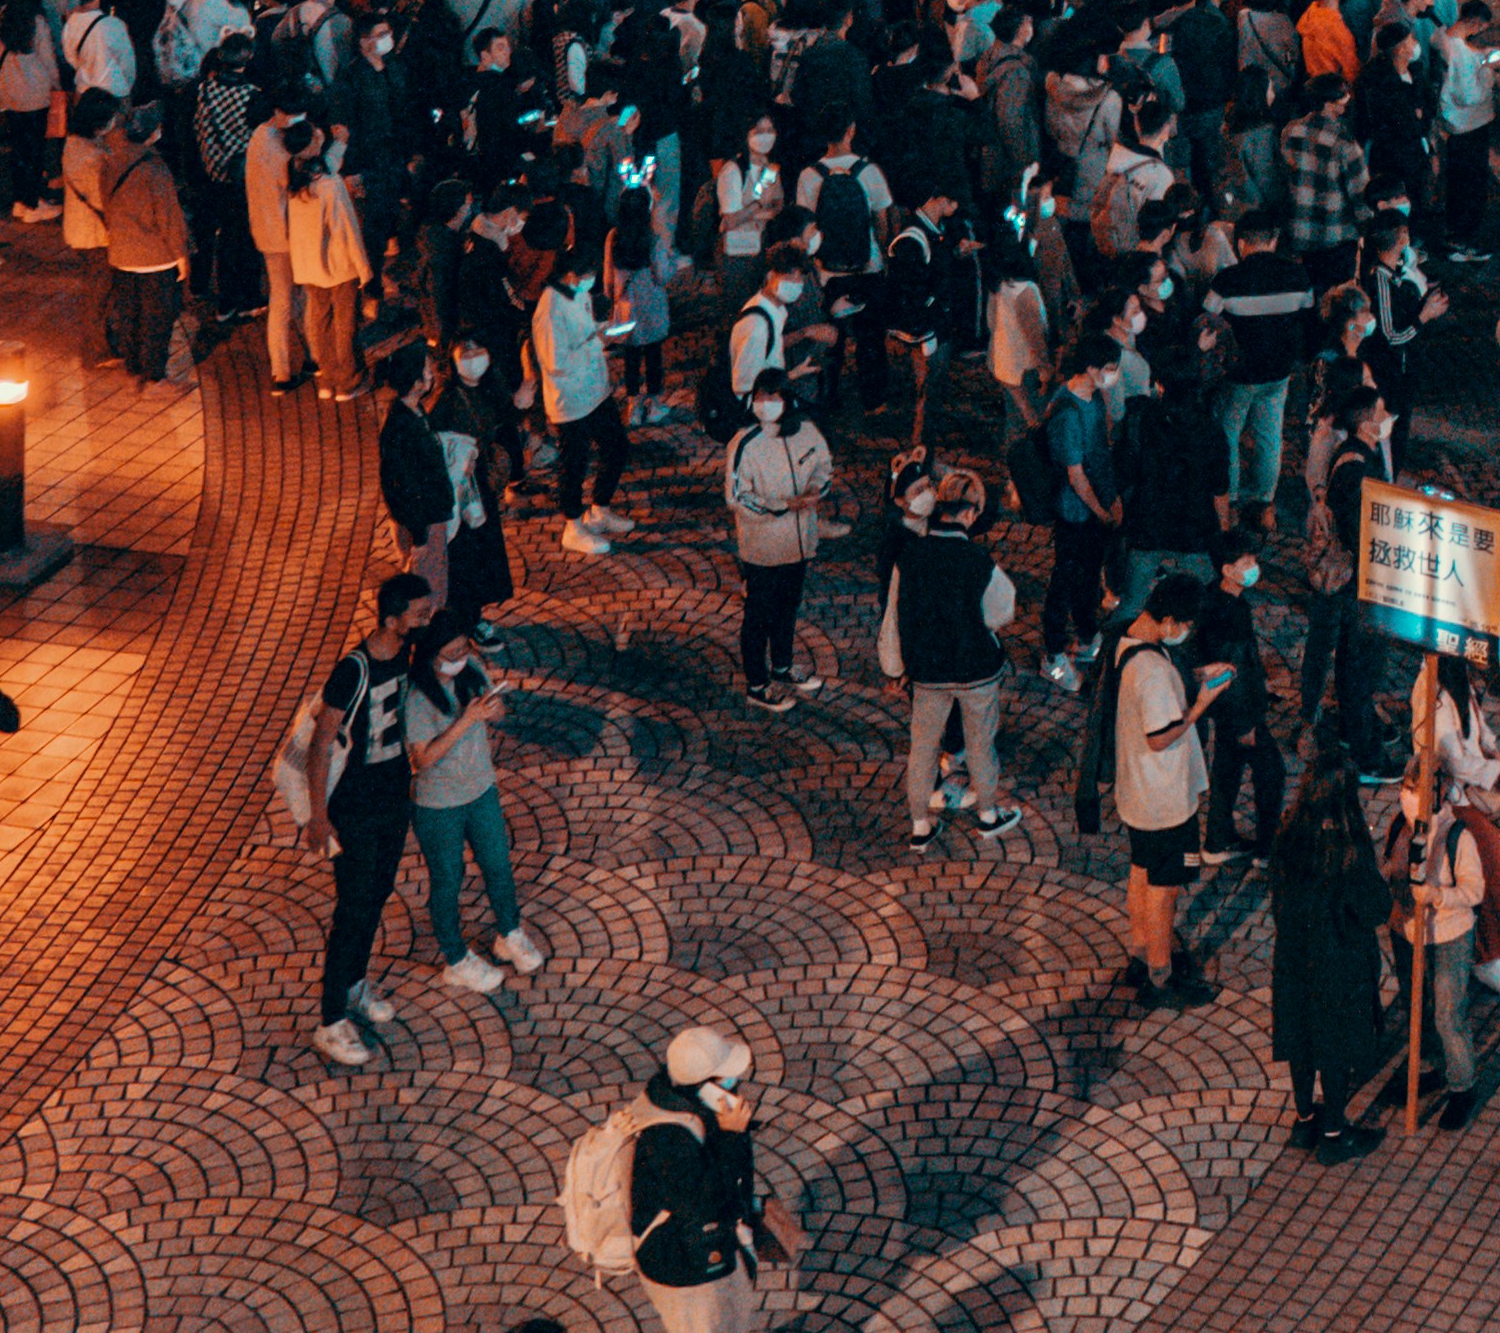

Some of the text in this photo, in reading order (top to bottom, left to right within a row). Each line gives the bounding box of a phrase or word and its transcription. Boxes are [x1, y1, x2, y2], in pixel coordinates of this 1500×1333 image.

[1370, 501, 1495, 555] 耶穌來是要
[1369, 538, 1464, 588] 拯救世人
[1437, 628, 1490, 665] 聖經
